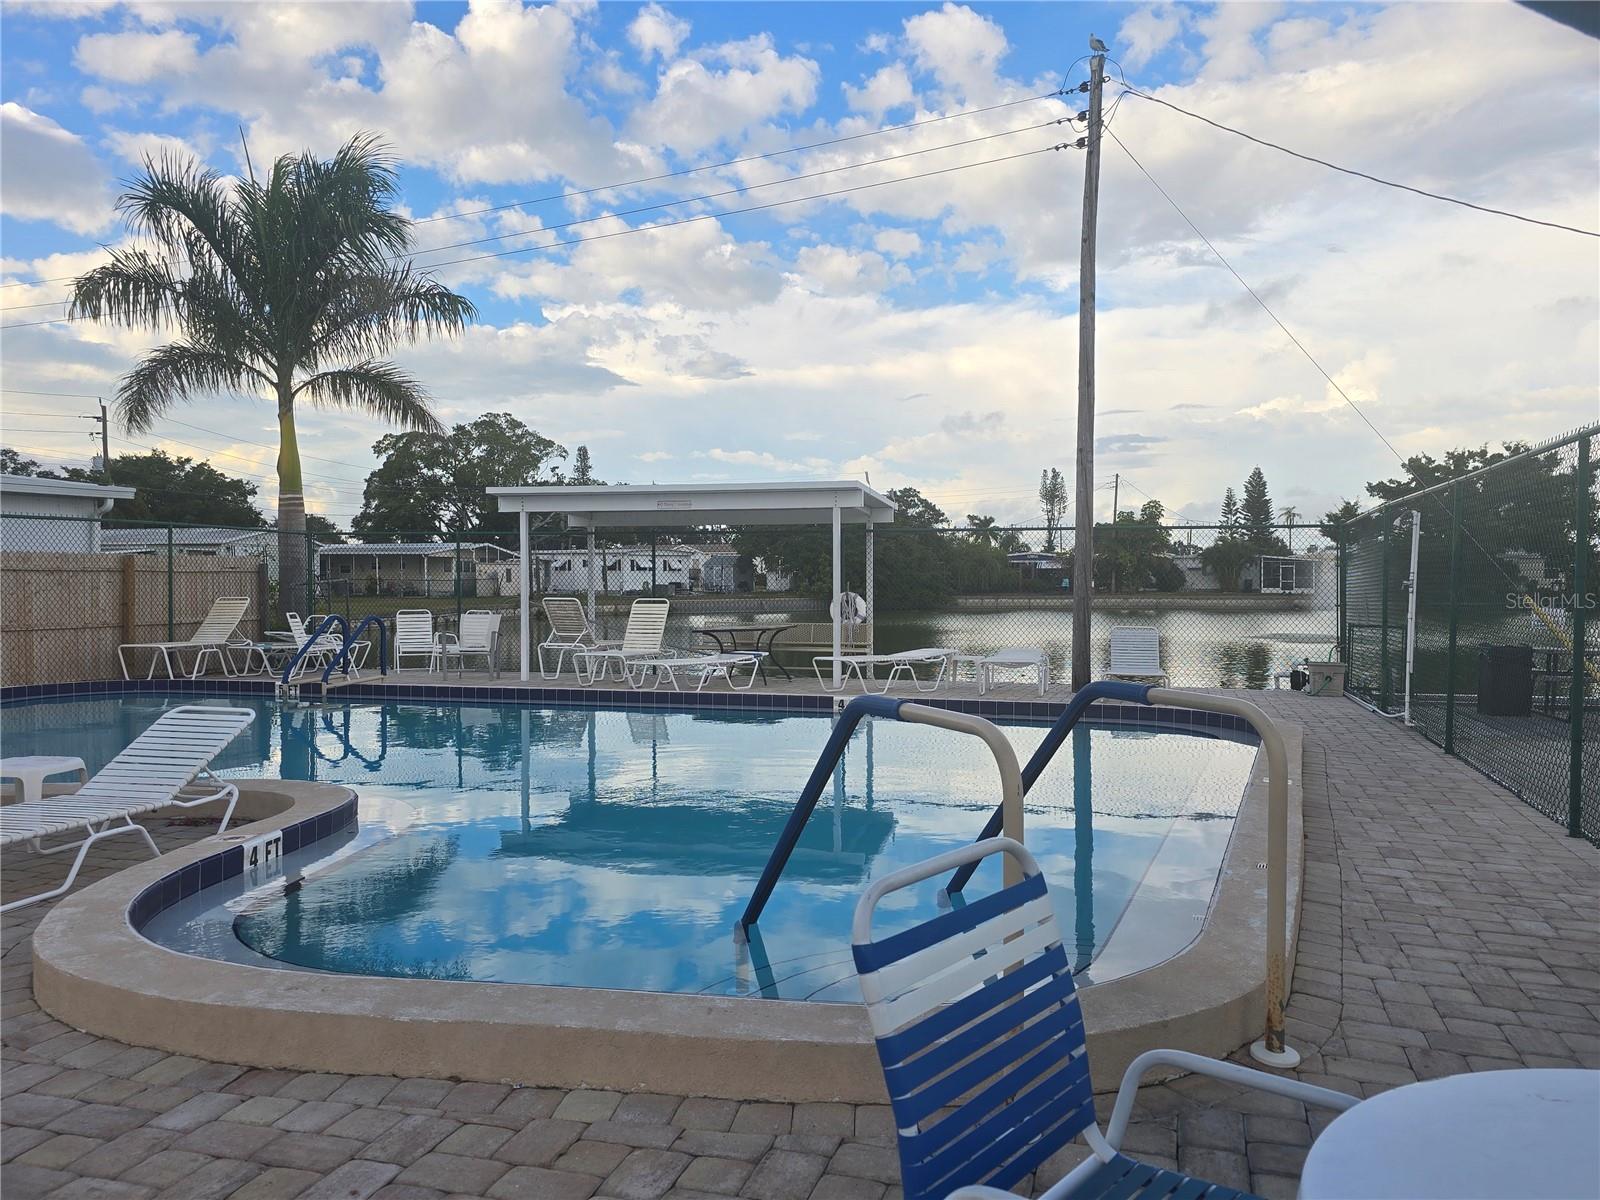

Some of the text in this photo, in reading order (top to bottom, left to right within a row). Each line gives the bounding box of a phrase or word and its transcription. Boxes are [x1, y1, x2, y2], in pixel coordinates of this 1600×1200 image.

[838, 699, 845, 709] 4
[250, 836, 281, 867] 4 FT
